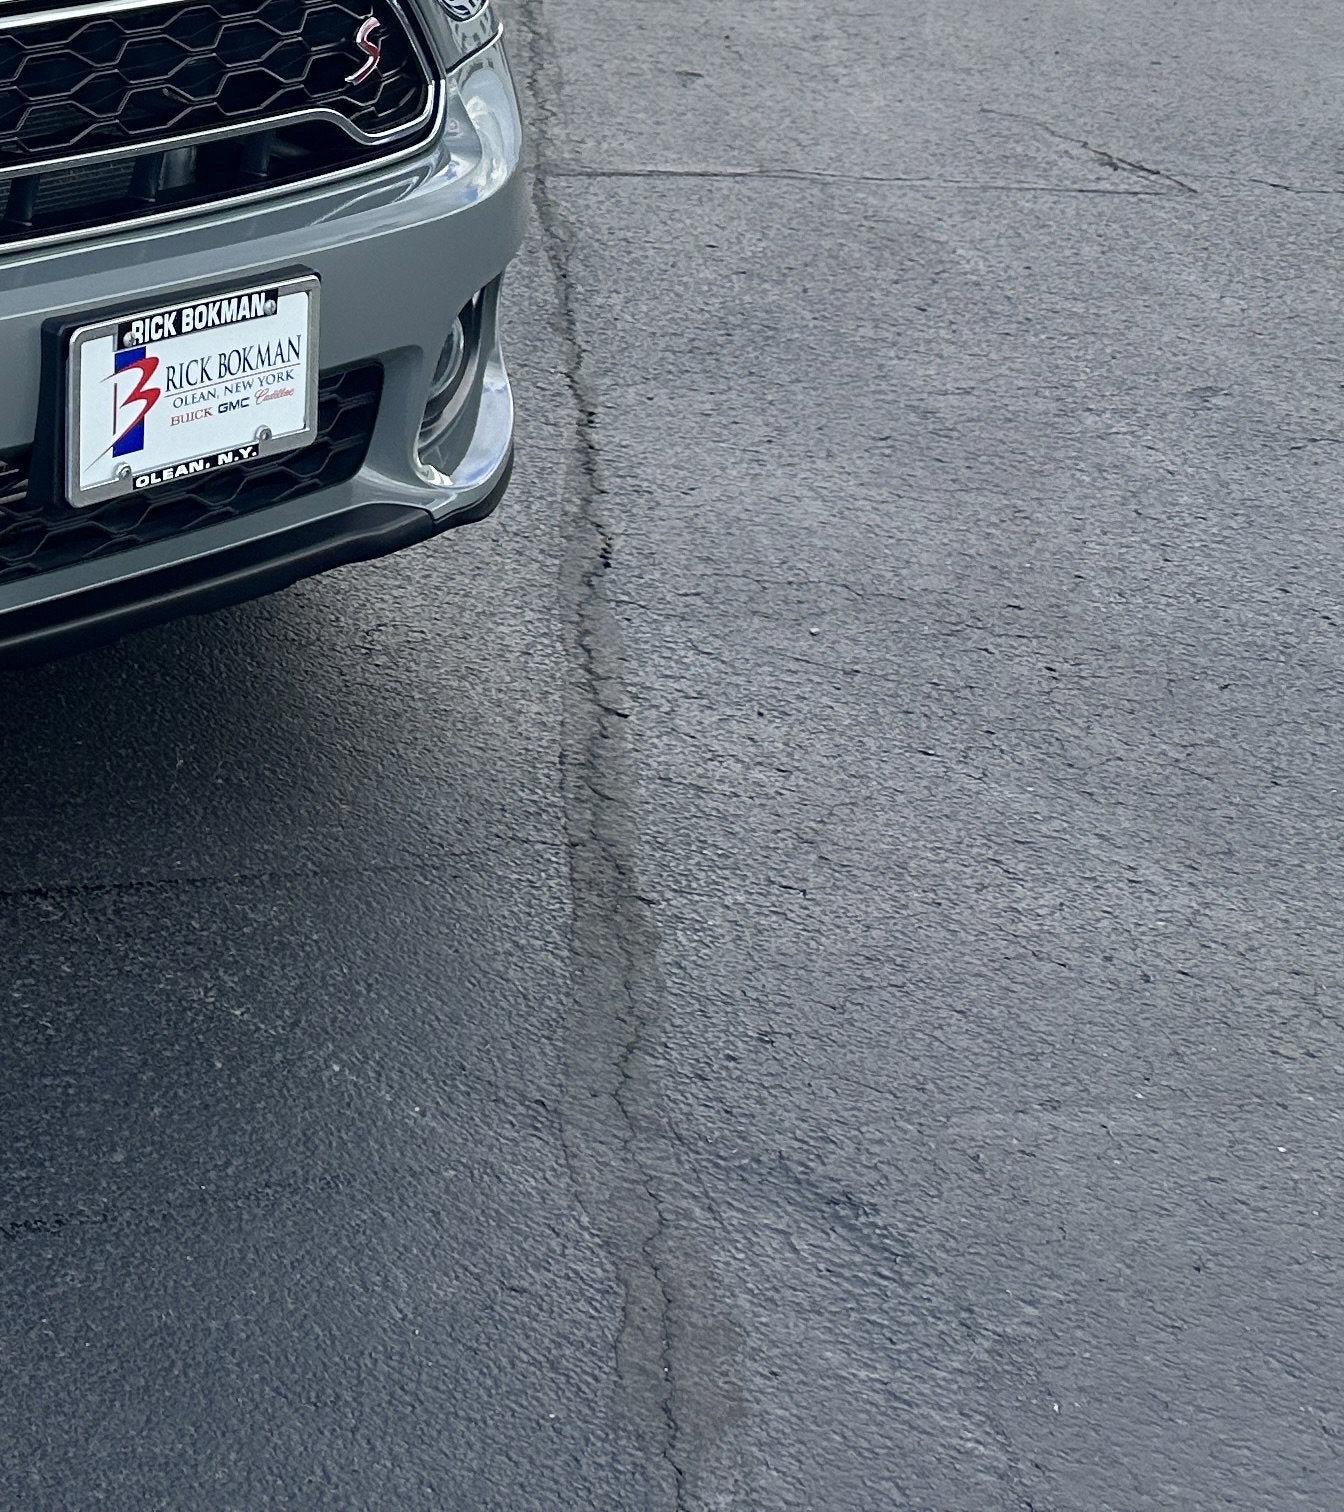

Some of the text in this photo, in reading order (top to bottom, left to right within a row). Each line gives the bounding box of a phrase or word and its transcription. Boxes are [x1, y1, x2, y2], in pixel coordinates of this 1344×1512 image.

[131, 292, 266, 346] RICK BOKMAN
[165, 334, 302, 393] RICK BOKMAN
[224, 378, 254, 396] NEW
[257, 369, 295, 388] YORK
[170, 406, 214, 427] BUICK
[217, 396, 250, 414] GMC
[217, 446, 257, 466] N.Y.
